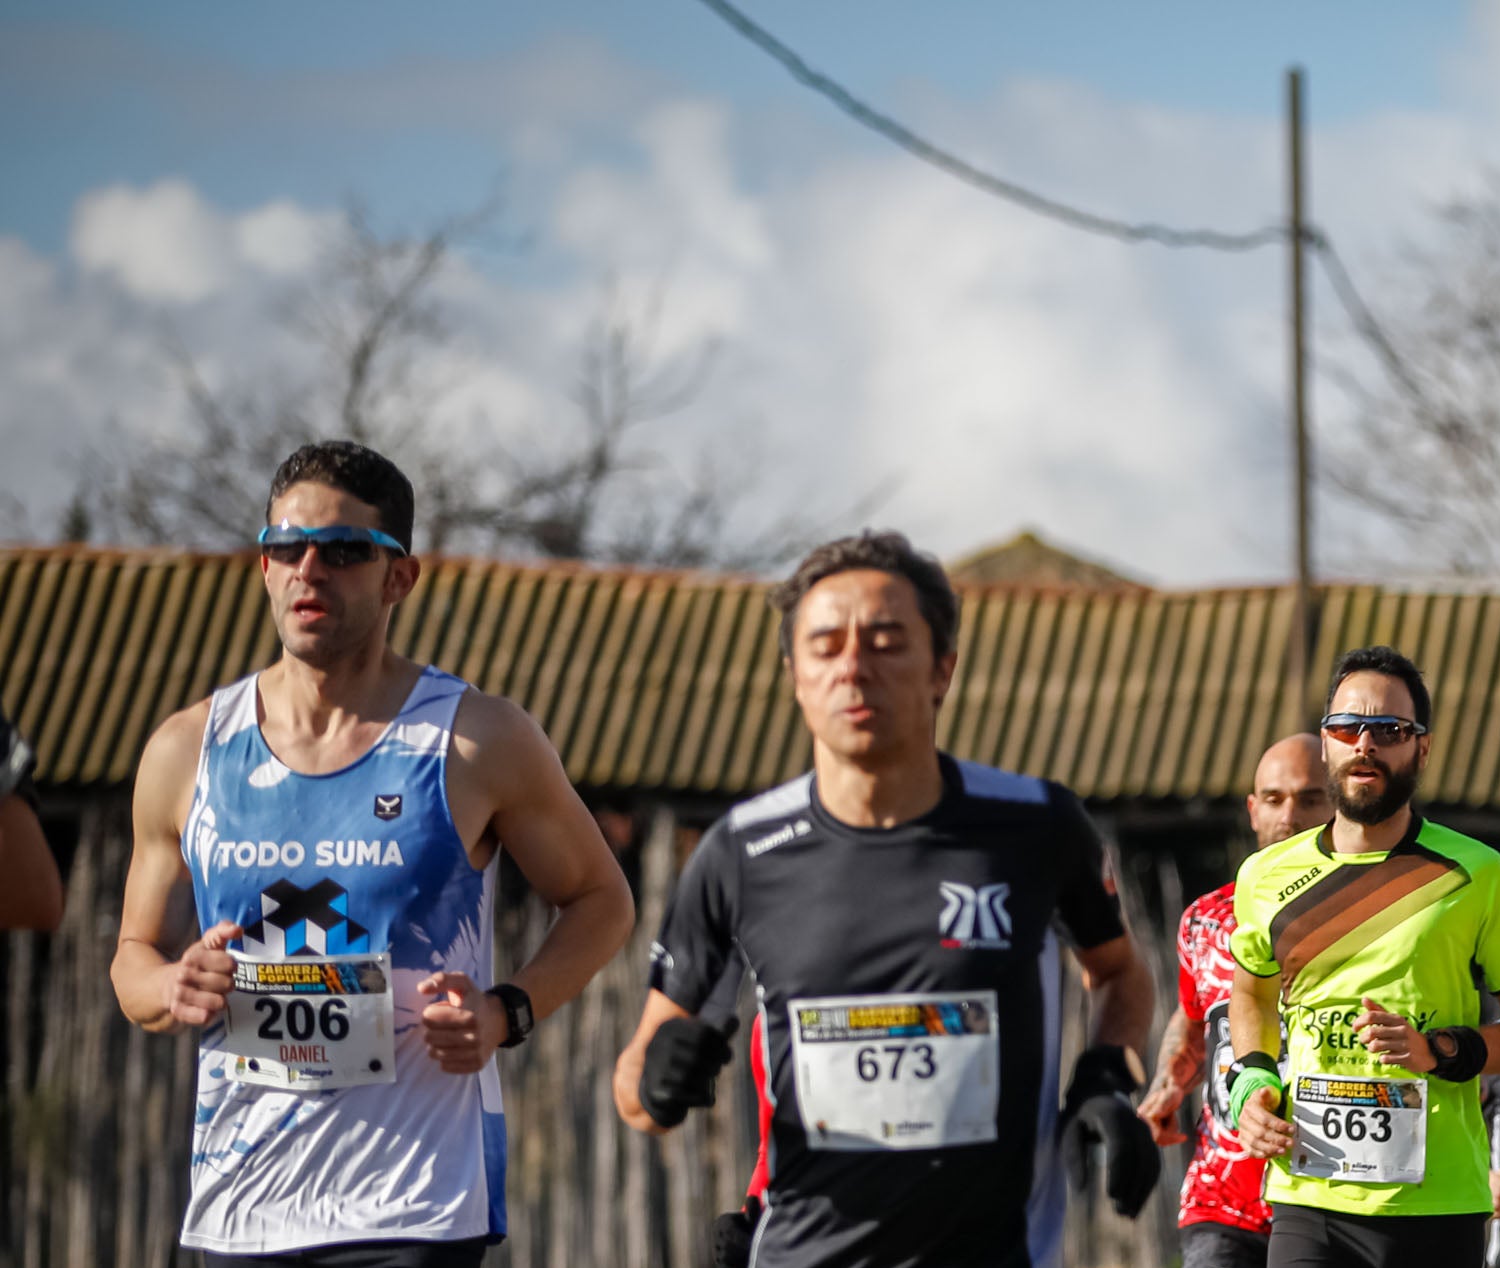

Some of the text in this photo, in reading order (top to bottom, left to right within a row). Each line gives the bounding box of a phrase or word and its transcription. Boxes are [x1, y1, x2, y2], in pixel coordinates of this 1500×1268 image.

[217, 840, 404, 867] TODO SUMA
[257, 964, 321, 975] CARRERA
[258, 973, 321, 983] POPULAR
[254, 998, 350, 1041] 206
[279, 1045, 330, 1064] DANIEL
[856, 1044, 938, 1083] 673
[1328, 1081, 1376, 1091] CARRERA
[1322, 1107, 1393, 1144] 663
